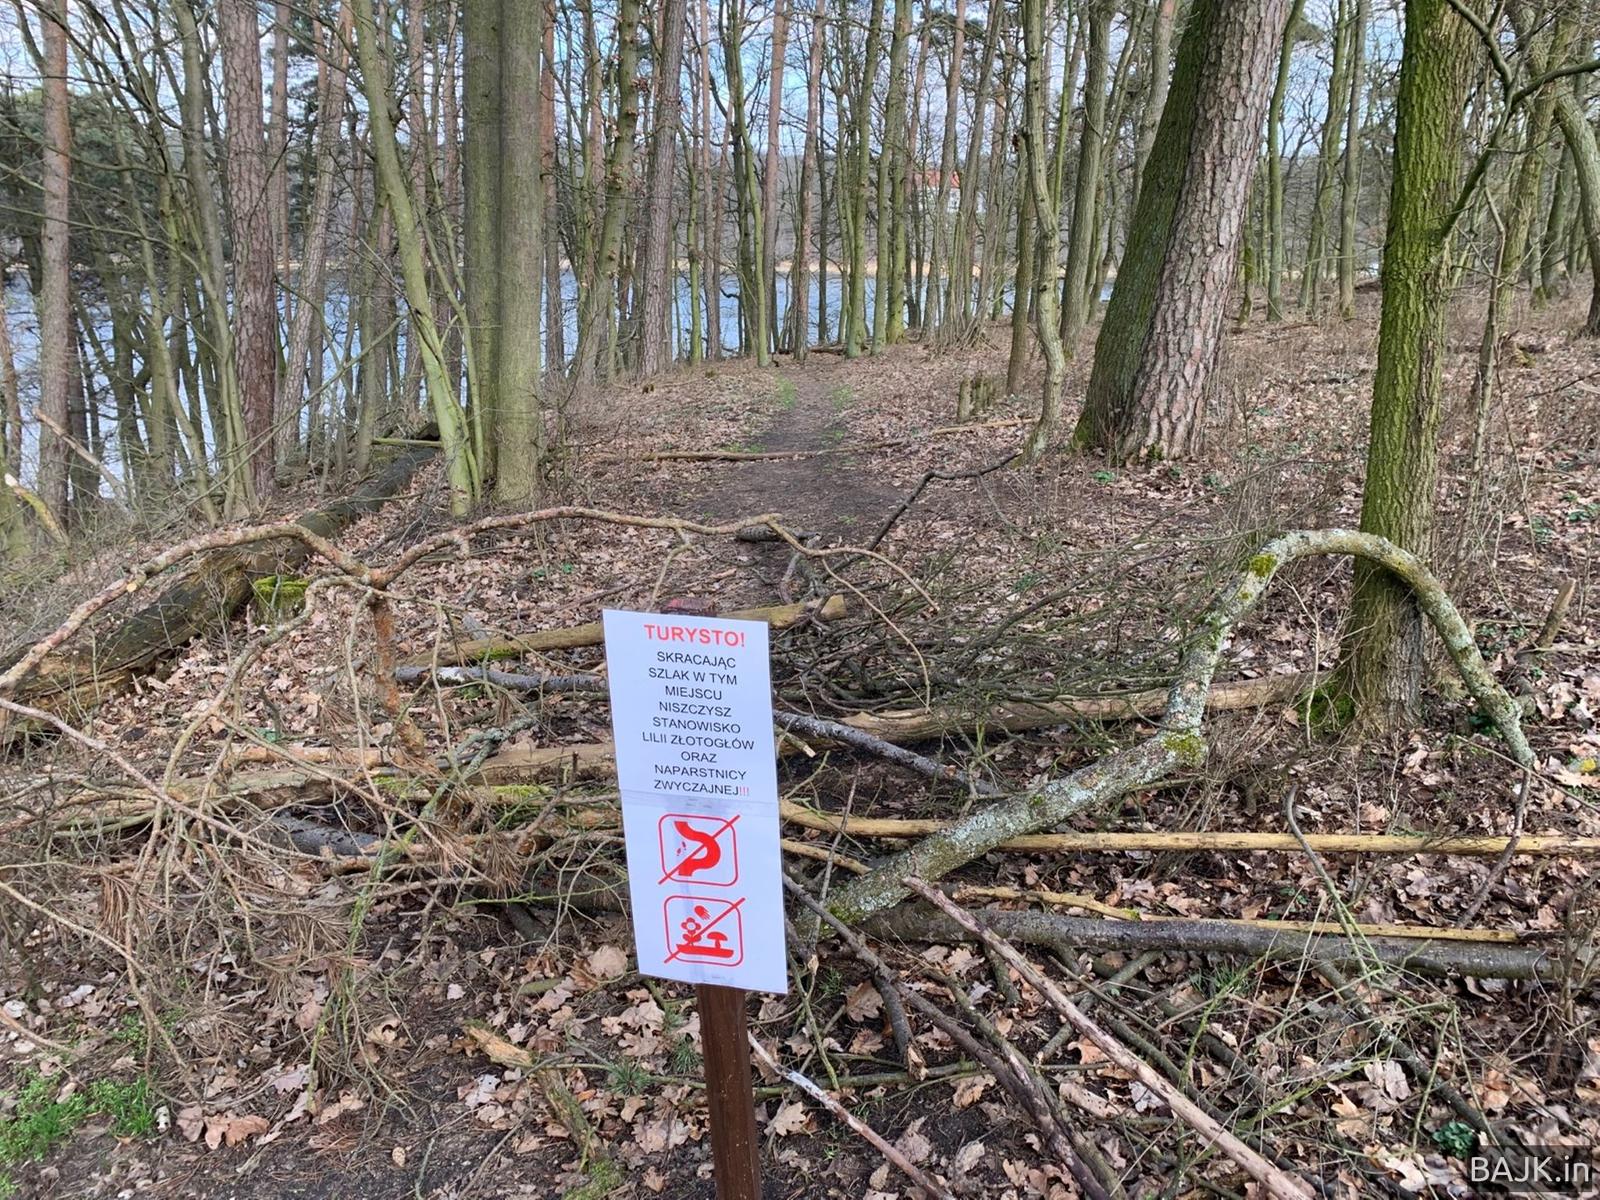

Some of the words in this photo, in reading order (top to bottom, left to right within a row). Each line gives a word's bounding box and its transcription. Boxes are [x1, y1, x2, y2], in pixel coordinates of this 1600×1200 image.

[644, 624, 745, 648] TURYSTO!
[657, 651, 736, 670] SKRACAJĄC
[648, 667, 690, 681] SZLAK
[693, 671, 706, 682] W
[709, 673, 737, 685] TYM
[665, 685, 722, 700] MIEJSCU
[659, 701, 732, 717] NISZCZYSZ
[652, 716, 741, 734] STANOWISKO
[642, 732, 667, 743] LILII
[670, 734, 754, 750] ZŁOTOGŁÓW
[680, 751, 717, 763] ORAZ
[654, 764, 747, 780] NAPARSTNICY
[654, 780, 750, 796] ZWYCZAJNEJ!!!
